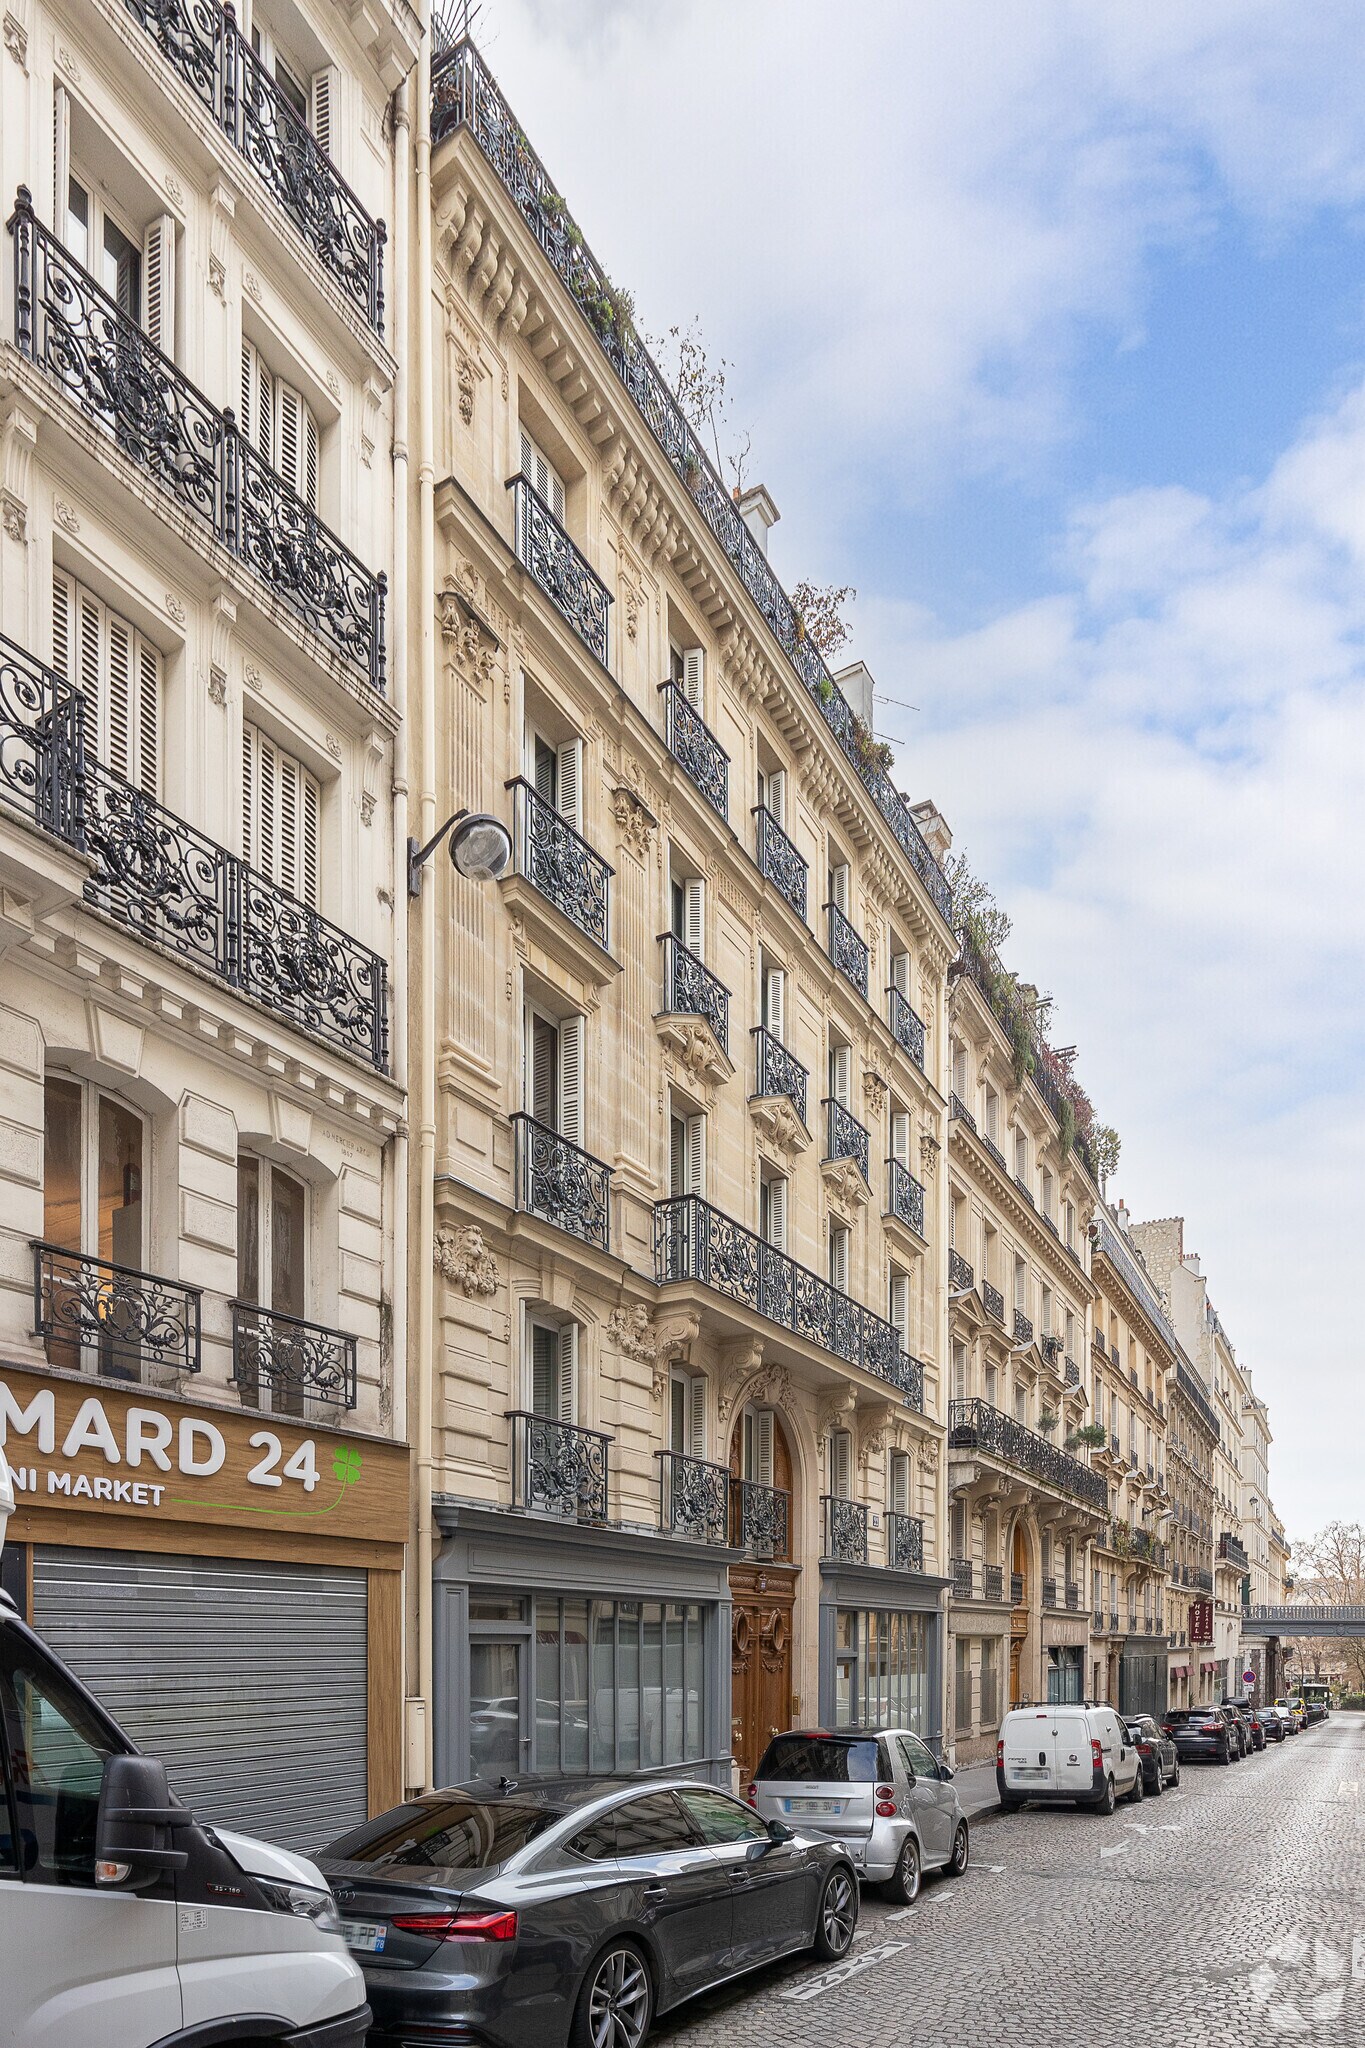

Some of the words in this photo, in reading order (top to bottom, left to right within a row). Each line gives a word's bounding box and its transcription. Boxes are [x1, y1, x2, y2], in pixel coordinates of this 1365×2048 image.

[246, 1431, 321, 1492] 24
[47, 1470, 166, 1507] MARKET
[376, 1939, 385, 1949] 78
